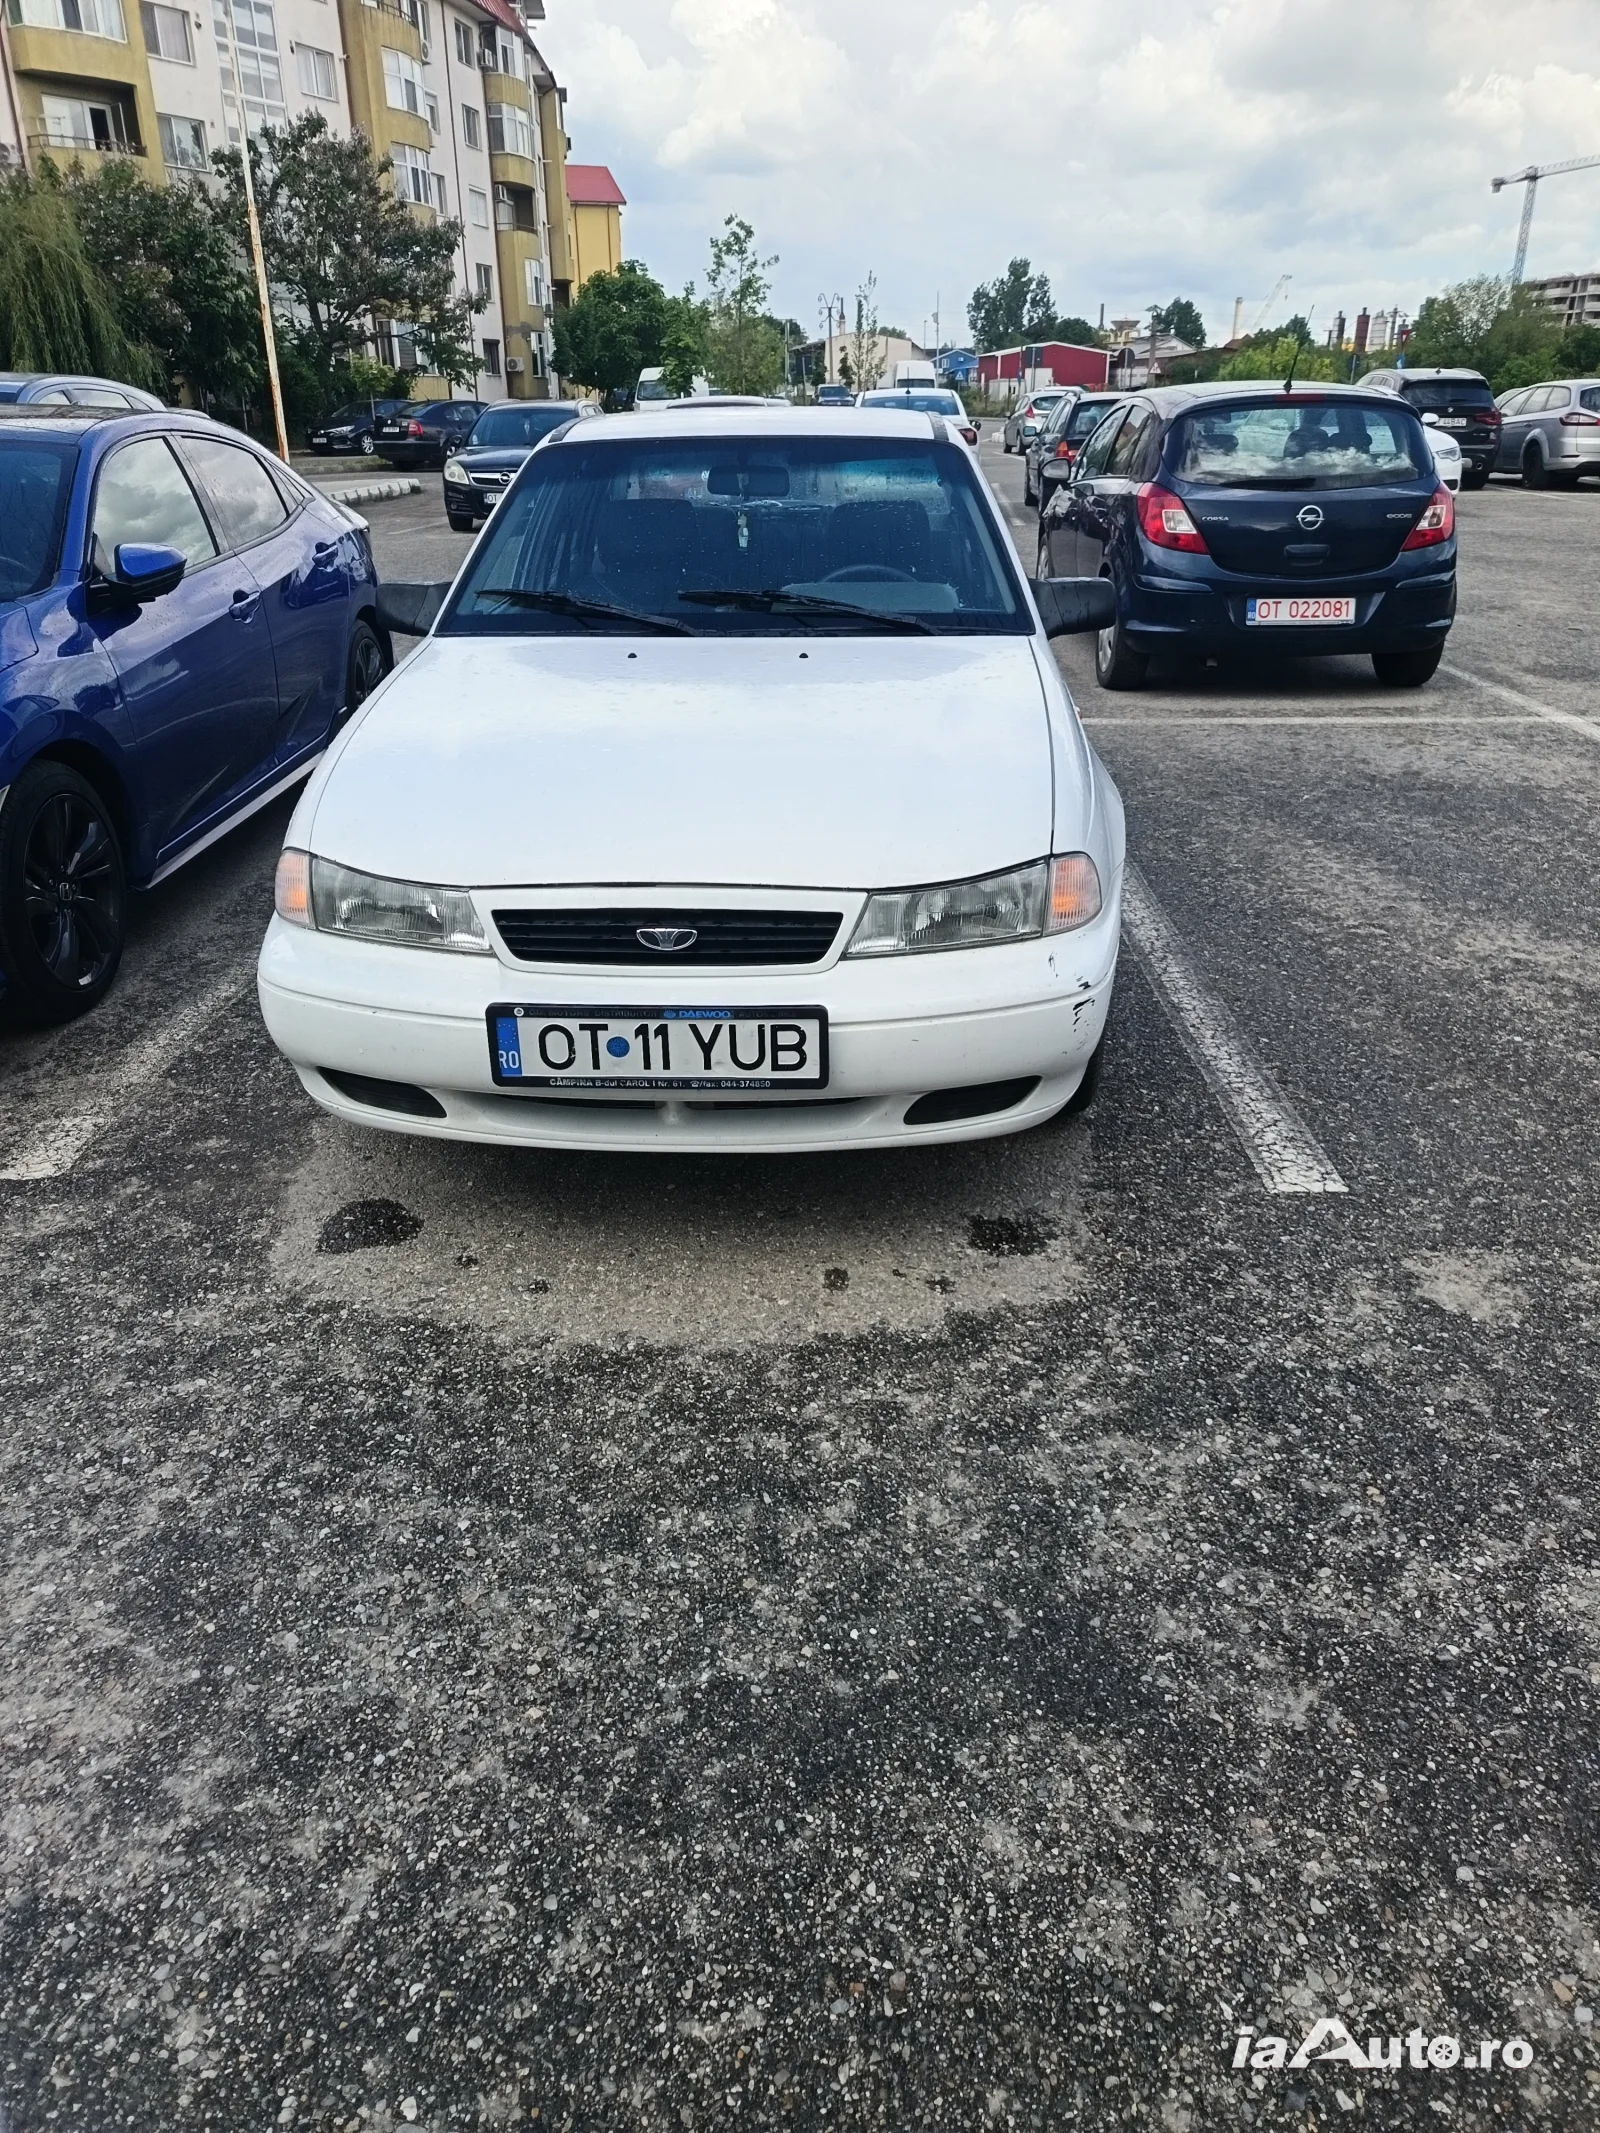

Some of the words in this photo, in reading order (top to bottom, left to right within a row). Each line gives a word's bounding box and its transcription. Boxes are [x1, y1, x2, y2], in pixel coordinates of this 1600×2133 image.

[1248, 611, 1256, 619] RO
[1258, 601, 1282, 619] OT
[1289, 600, 1350, 618] 022081
[679, 1010, 731, 1019] DAEWOO
[738, 1010, 797, 1018] AUTOMBILE
[538, 1023, 609, 1071] OT
[634, 1023, 671, 1071] 11
[688, 1023, 808, 1072] YUB
[498, 1050, 519, 1069] RO
[595, 1079, 617, 1087] B-dul
[620, 1079, 650, 1087] CAROL
